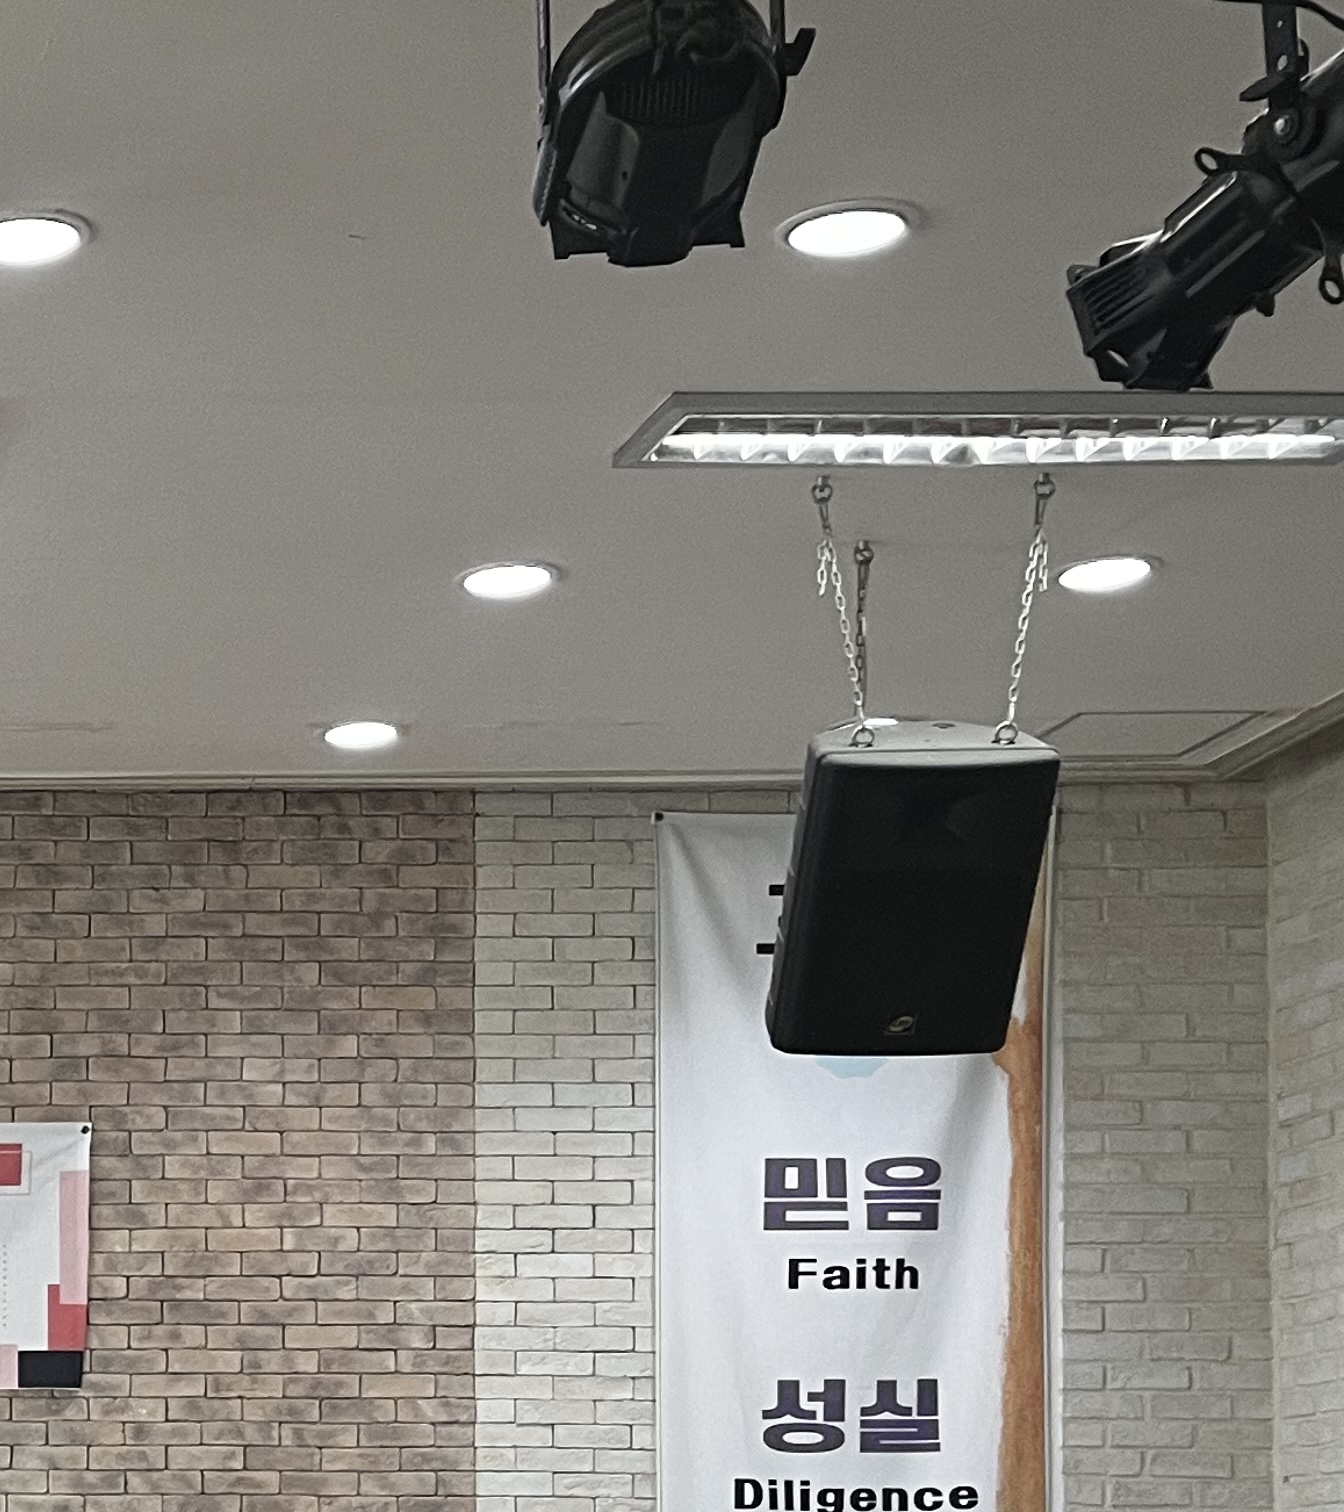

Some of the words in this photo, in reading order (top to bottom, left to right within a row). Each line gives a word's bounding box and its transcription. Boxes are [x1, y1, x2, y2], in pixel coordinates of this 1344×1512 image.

[762, 1156, 942, 1231] 믿음
[788, 1257, 919, 1290] Faith
[761, 1378, 941, 1454] 성실
